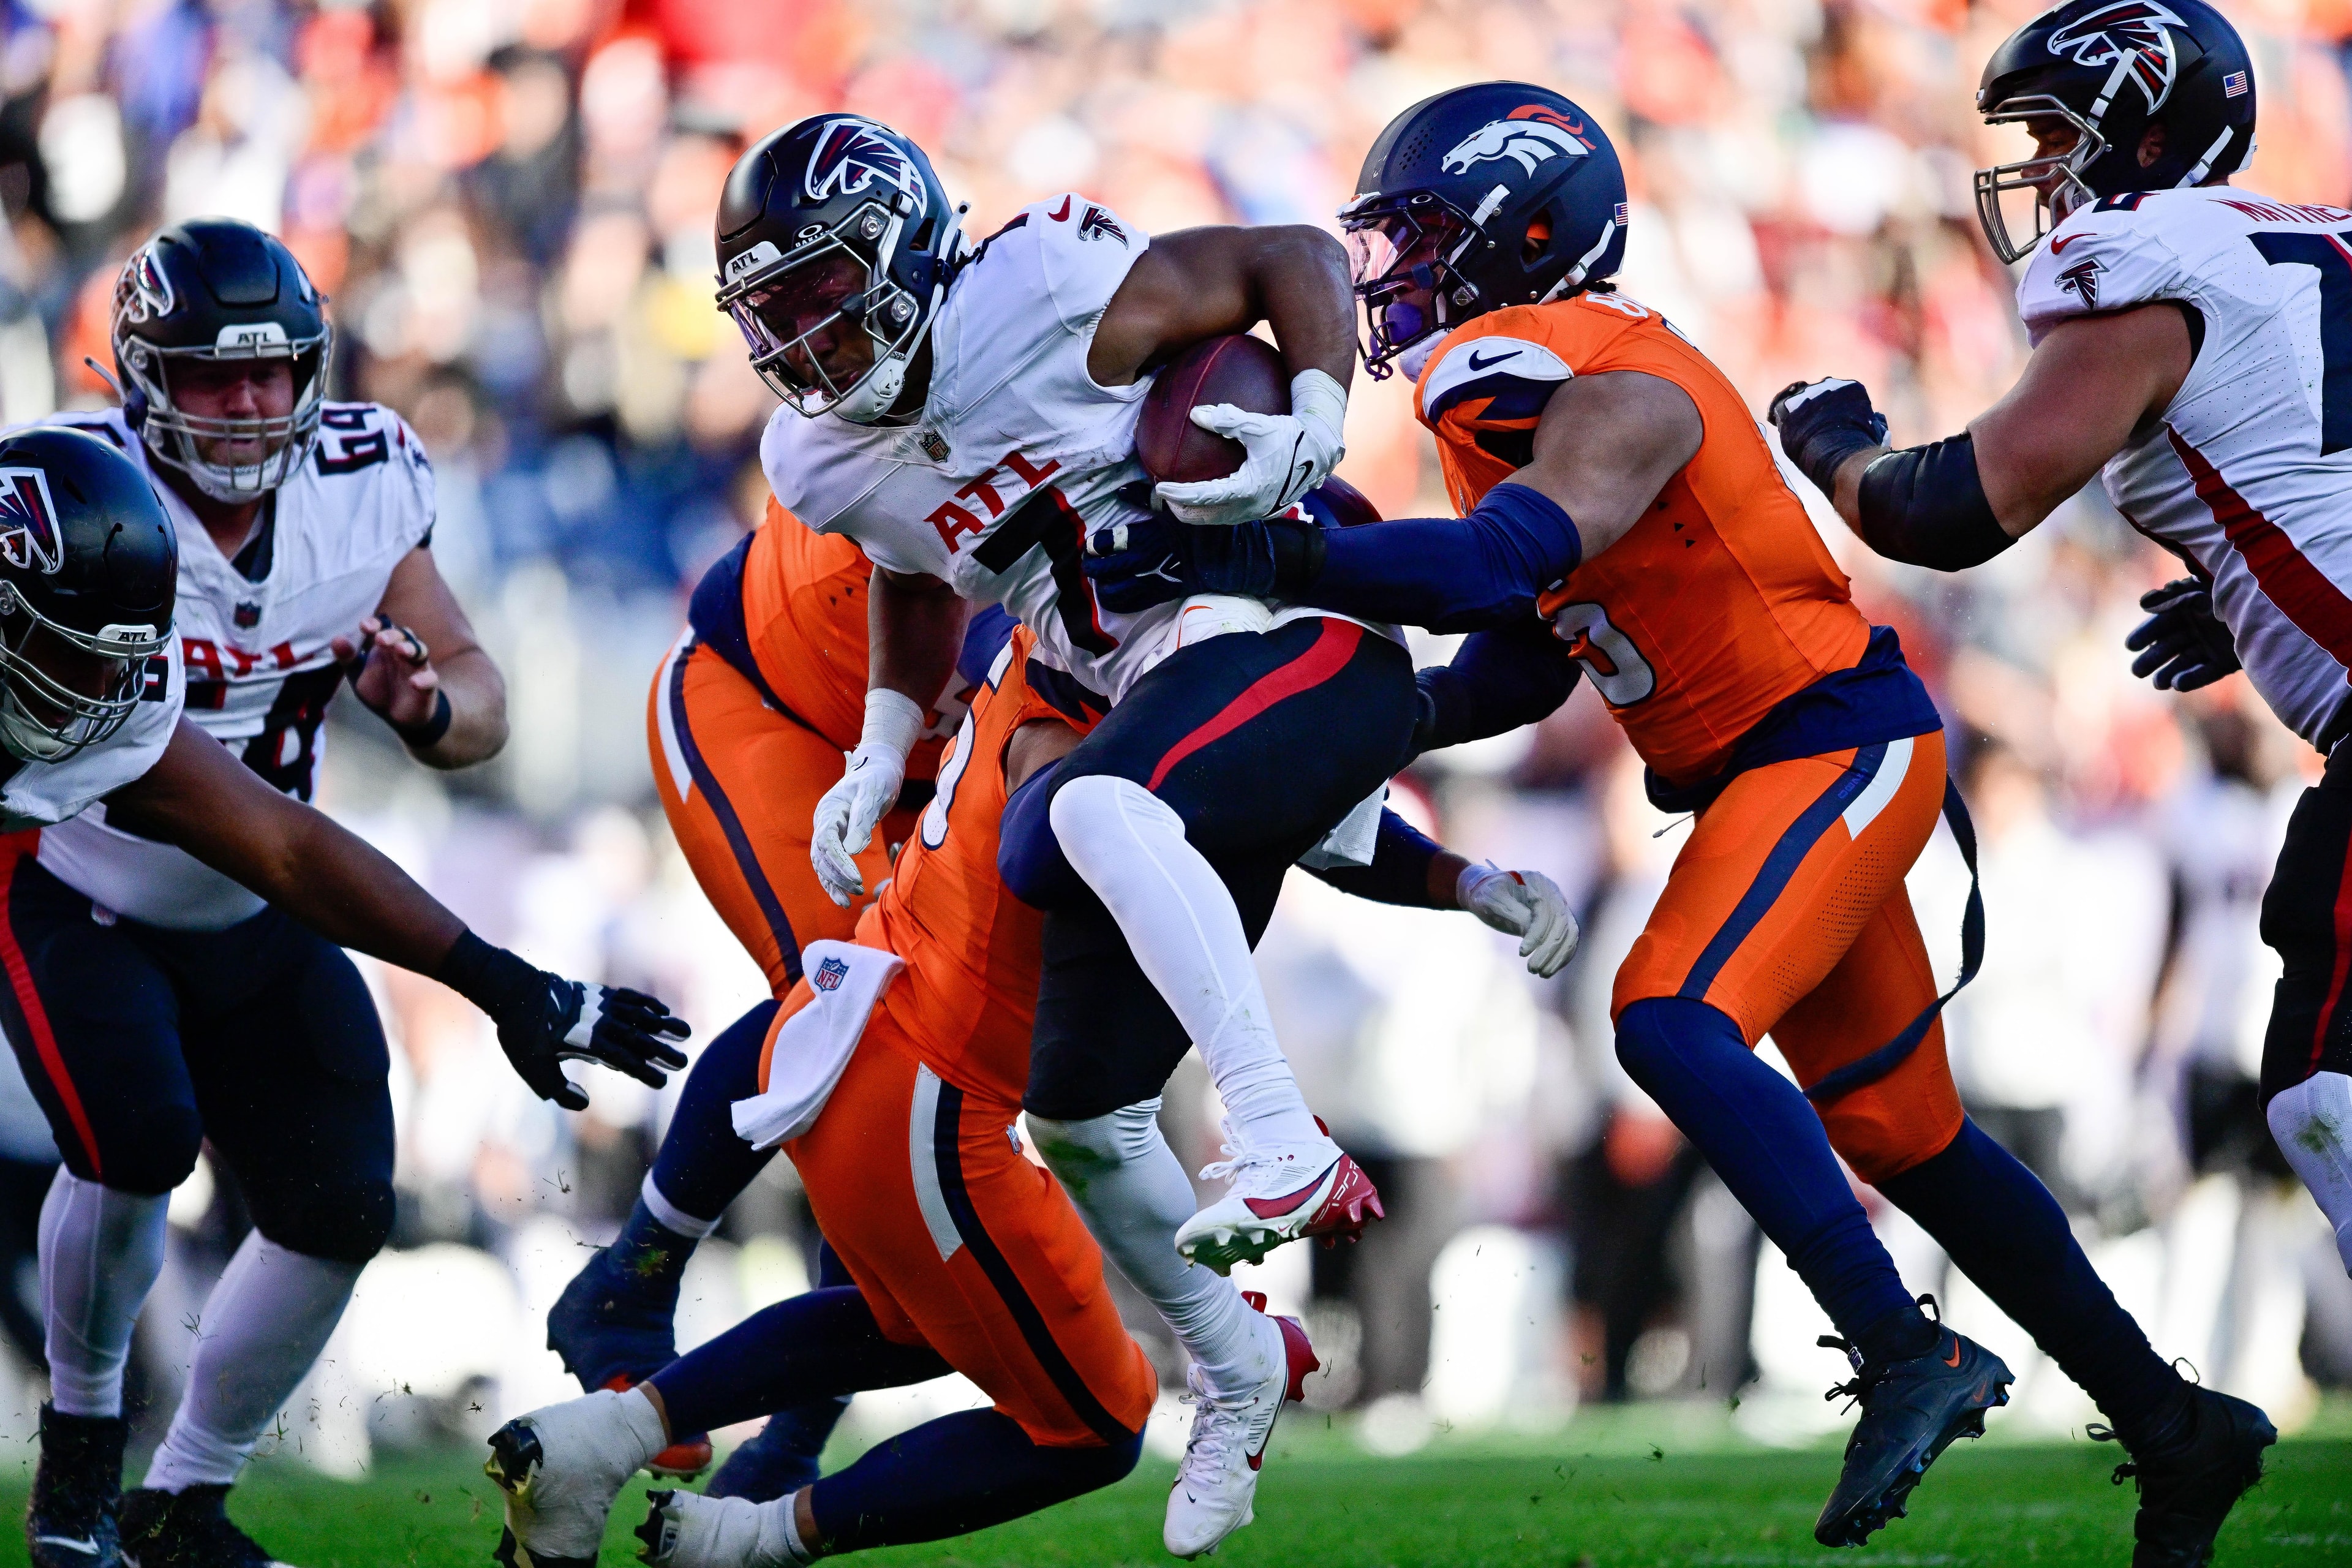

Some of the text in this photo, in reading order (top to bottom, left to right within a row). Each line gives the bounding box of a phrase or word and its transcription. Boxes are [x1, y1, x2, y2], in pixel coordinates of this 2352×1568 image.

[795, 230, 834, 247] OAK
[731, 252, 759, 274] ATL
[238, 332, 271, 344] ATL
[2245, 231, 2352, 458] 7
[928, 441, 948, 459] NFL
[923, 450, 1062, 554] ATL
[971, 484, 1120, 659] 7
[118, 631, 147, 642] ATL
[182, 638, 316, 679] ATL
[816, 969, 839, 989] NFL
